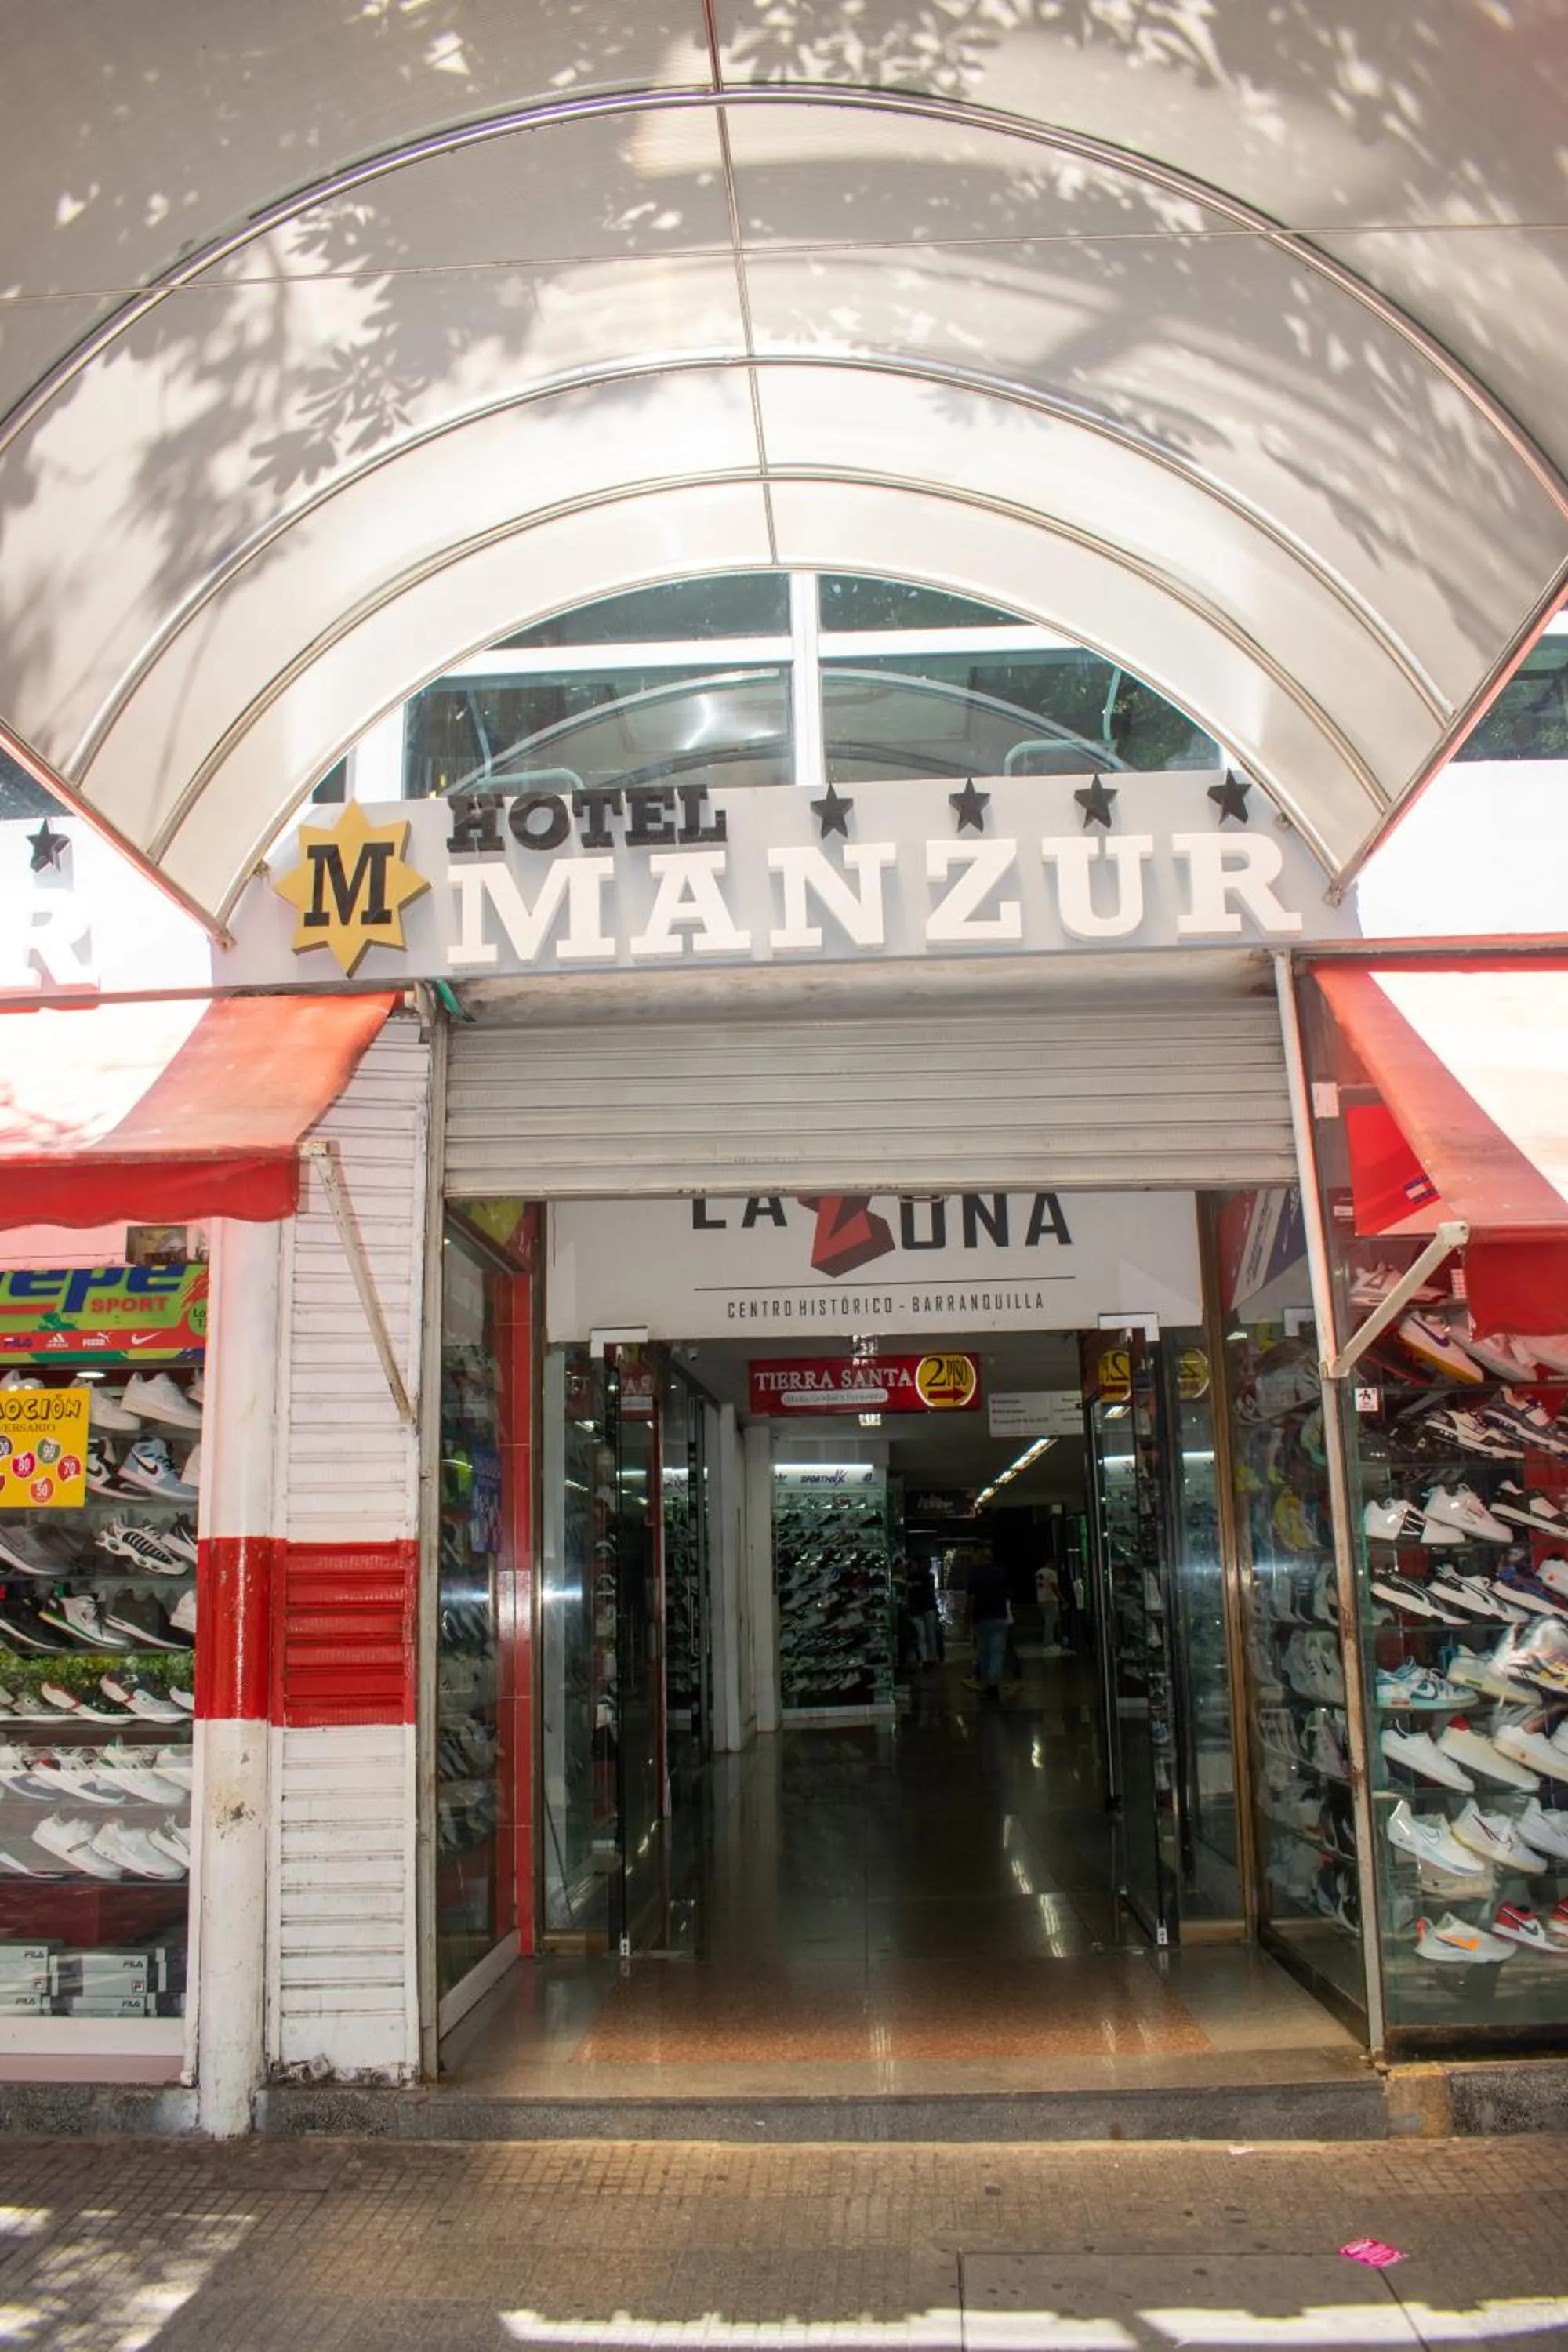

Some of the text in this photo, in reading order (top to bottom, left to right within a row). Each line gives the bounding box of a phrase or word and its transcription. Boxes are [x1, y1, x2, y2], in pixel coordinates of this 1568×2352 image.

[446, 784, 728, 853] HOTEL
[303, 842, 394, 927] M
[447, 832, 1303, 964] MANZUR
[90, 1296, 169, 1315] SPORT
[727, 1300, 791, 1319] CENTRO
[912, 1292, 1044, 1313] BARRANQUILLA
[754, 1367, 913, 1392] TIERRA SANTA
[925, 1357, 946, 1387] 2
[0, 1393, 82, 1421] OCIÓN
